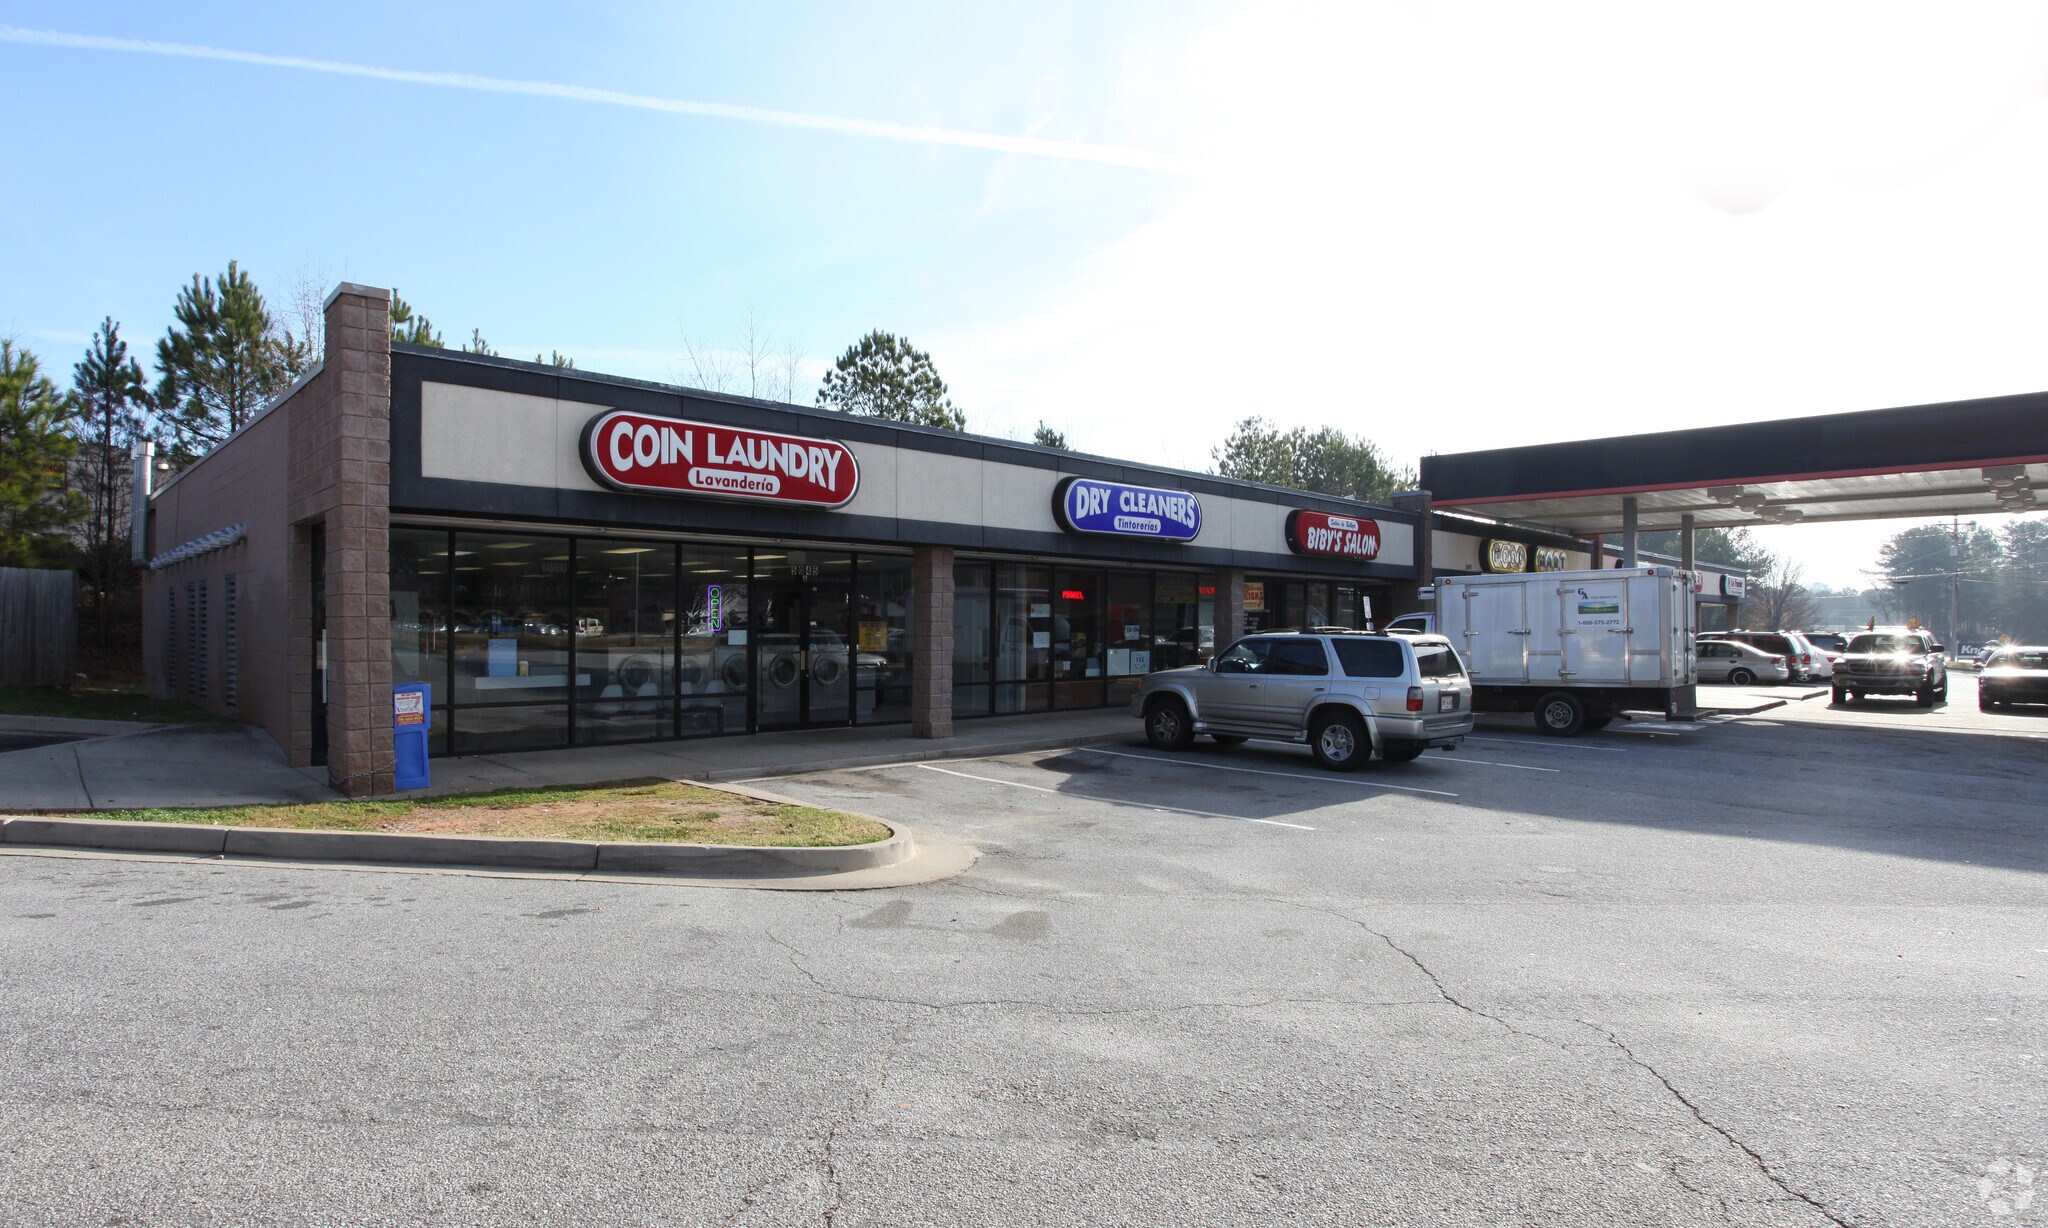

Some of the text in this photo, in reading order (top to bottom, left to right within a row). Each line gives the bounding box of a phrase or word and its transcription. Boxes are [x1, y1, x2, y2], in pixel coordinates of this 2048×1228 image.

[610, 421, 842, 492] COIN LAUNDRY
[696, 470, 774, 492] Lavandería
[1076, 486, 1196, 529] DRY CLEANERS
[1307, 526, 1375, 556] BIBY'S SALON
[1492, 545, 1566, 570] FOOD MART
[710, 587, 720, 630] OPEN
[1960, 644, 1980, 655] Kn
